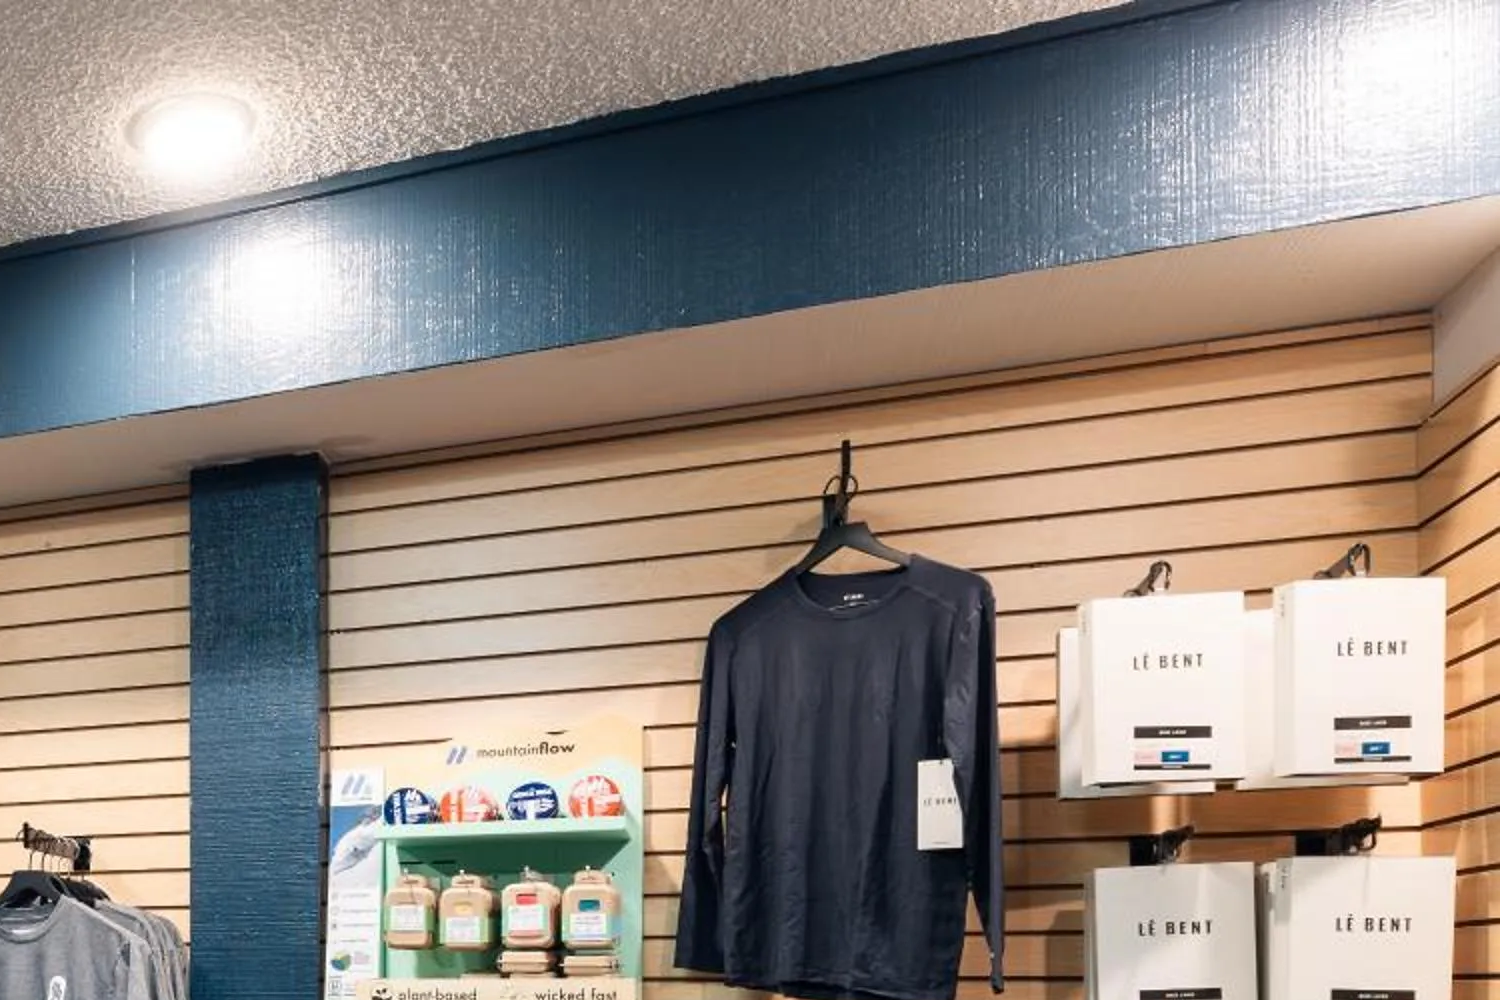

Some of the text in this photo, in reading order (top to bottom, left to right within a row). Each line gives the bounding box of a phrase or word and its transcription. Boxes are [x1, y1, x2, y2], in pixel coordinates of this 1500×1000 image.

[1363, 640, 1408, 656] BENT
[1159, 653, 1203, 669] BENT
[476, 741, 575, 758] mountainflow
[1165, 920, 1213, 936] BENT
[1364, 917, 1412, 932] BENT
